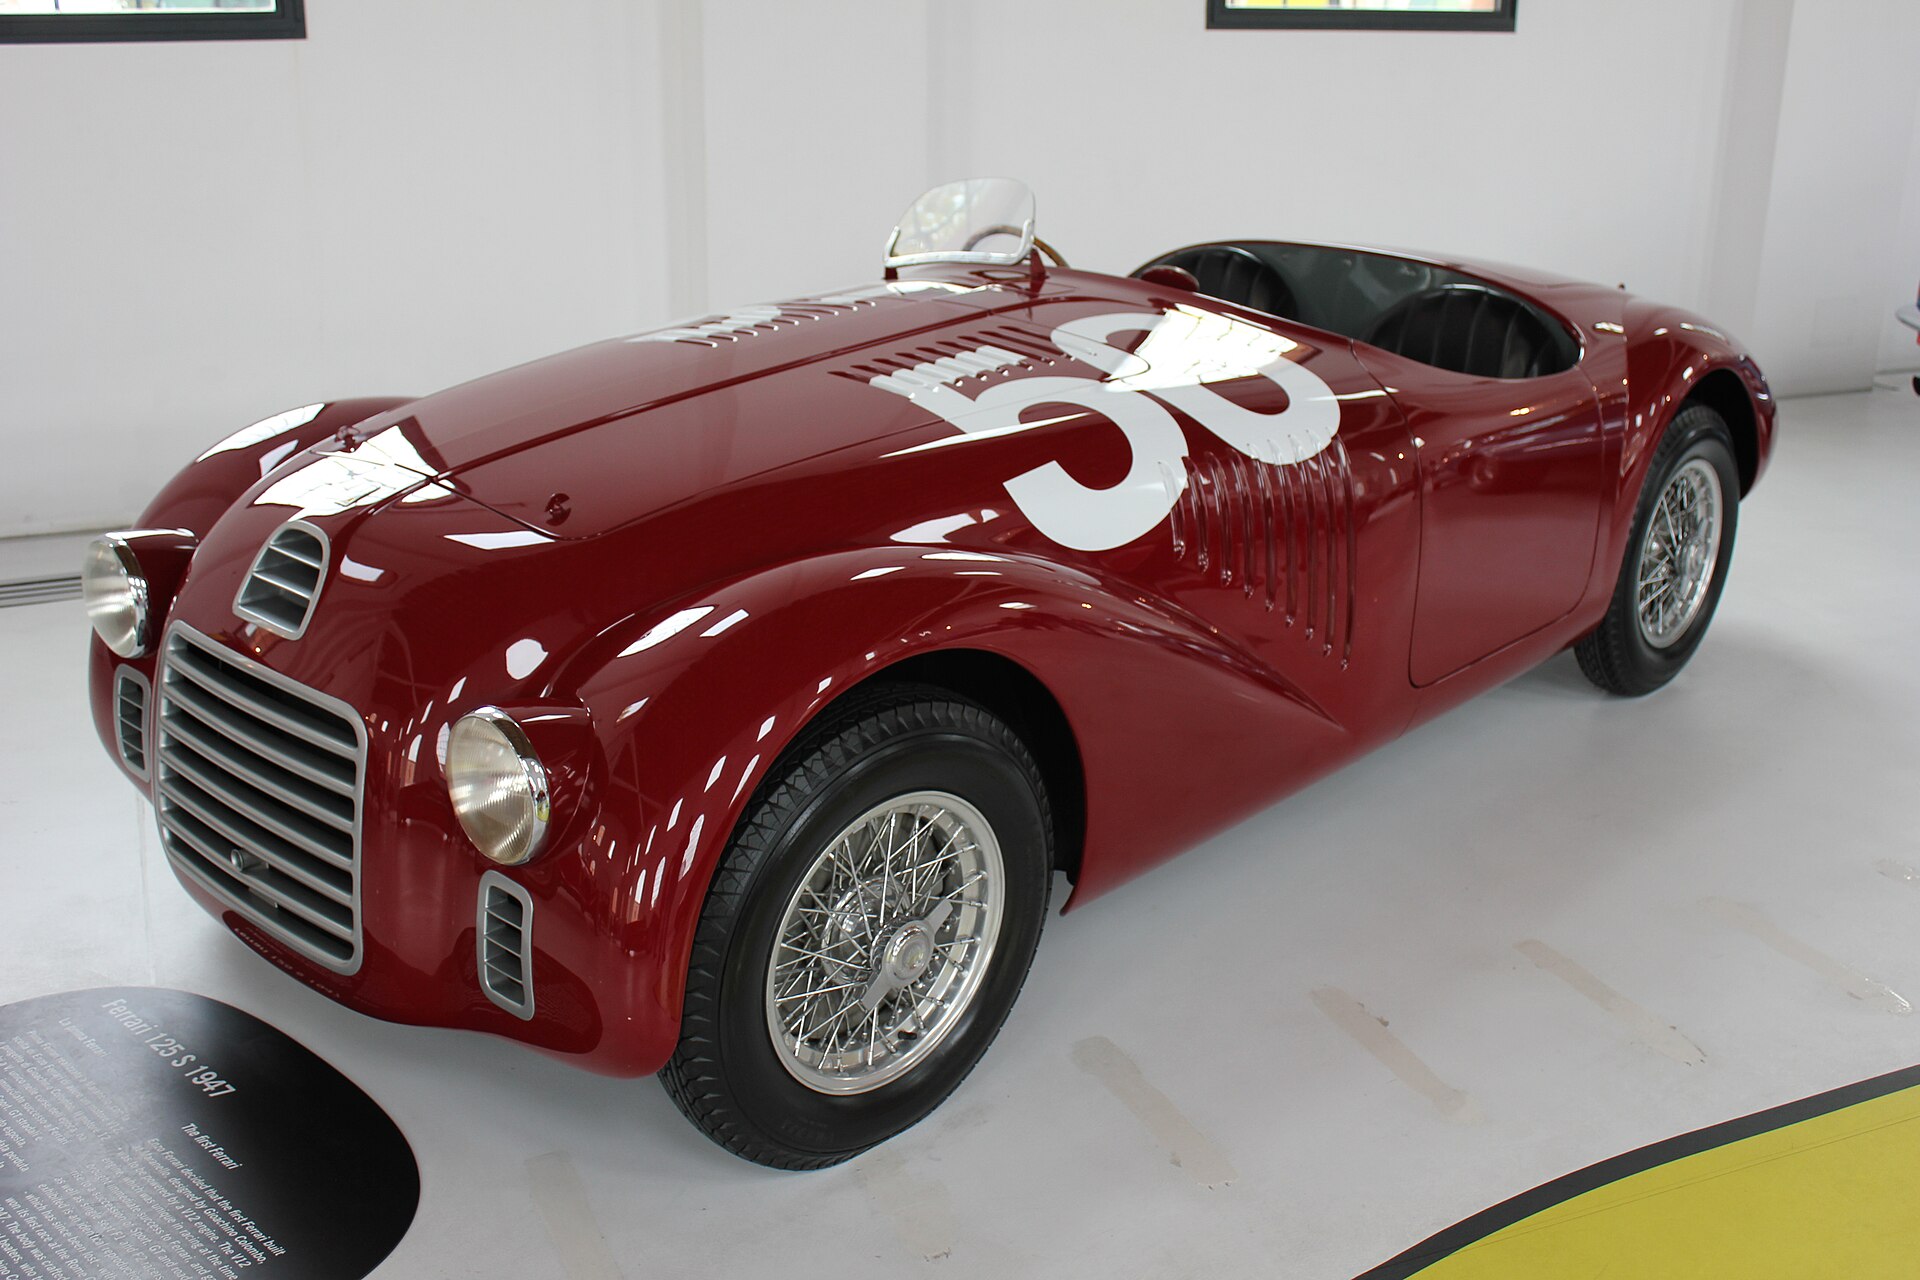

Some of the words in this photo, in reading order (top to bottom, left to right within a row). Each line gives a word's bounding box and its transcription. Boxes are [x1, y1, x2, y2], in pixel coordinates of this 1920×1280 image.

[83, 1038, 111, 1057] Ferrari
[102, 999, 158, 1035] Ferrari
[145, 1033, 185, 1057] 125
[171, 1054, 196, 1067] S
[185, 1066, 236, 1097] 1947
[3, 1151, 29, 1172] perduta
[48, 1127, 72, 1145] Ferrari
[181, 1123, 200, 1137] The
[194, 1135, 217, 1149] first
[209, 1147, 243, 1169] Ferrari
[38, 1184, 70, 1208] exhibited
[68, 1215, 81, 1223] an
[77, 1222, 109, 1248] identical
[141, 1175, 174, 1197] powered
[167, 1196, 180, 1205] by
[181, 1208, 201, 1222] V12
[194, 1222, 219, 1243] engine.
[218, 1241, 234, 1255] The
[231, 1253, 251, 1268] V12
[146, 1138, 165, 1152] Enzo
[161, 1151, 188, 1169] Ferrari
[181, 1168, 211, 1190] decided
[204, 1188, 224, 1201] that
[217, 1200, 232, 1211] the
[228, 1209, 248, 1223] first
[242, 1221, 271, 1241] Ferrari
[263, 1240, 286, 1256] built
[169, 1178, 202, 1201] designed
[195, 1200, 208, 1209] by
[204, 1208, 238, 1236] Gioachino
[235, 1236, 266, 1264] Colombo,
[5, 1197, 21, 1210] won
[16, 1208, 29, 1218] its
[24, 1216, 43, 1230] first
[35, 1229, 53, 1242] race
[48, 1242, 62, 1250] at
[55, 1248, 70, 1260] the
[65, 1258, 87, 1277] Rome
[6, 1221, 21, 1234] The
[16, 1233, 36, 1248] body
[30, 1248, 46, 1260] was
[41, 1260, 70, 1280] crafted
[25, 1194, 48, 1211] which
[41, 1209, 57, 1222] has
[52, 1221, 72, 1237] since
[67, 1236, 86, 1252] been
[82, 1251, 100, 1264] lost
[137, 1212, 164, 1235] success
[160, 1233, 172, 1241] to
[167, 1240, 196, 1263] Ferrari,
[190, 1263, 211, 1275] and
[151, 1203, 176, 1223] unique
[172, 1222, 184, 1230] in
[179, 1230, 204, 1249] racing
[207, 1254, 222, 1266] the
[20, 1263, 37, 1276] who
[149, 1245, 166, 1254] GT
[158, 1255, 178, 1267] and
[171, 1267, 193, 1280] road
